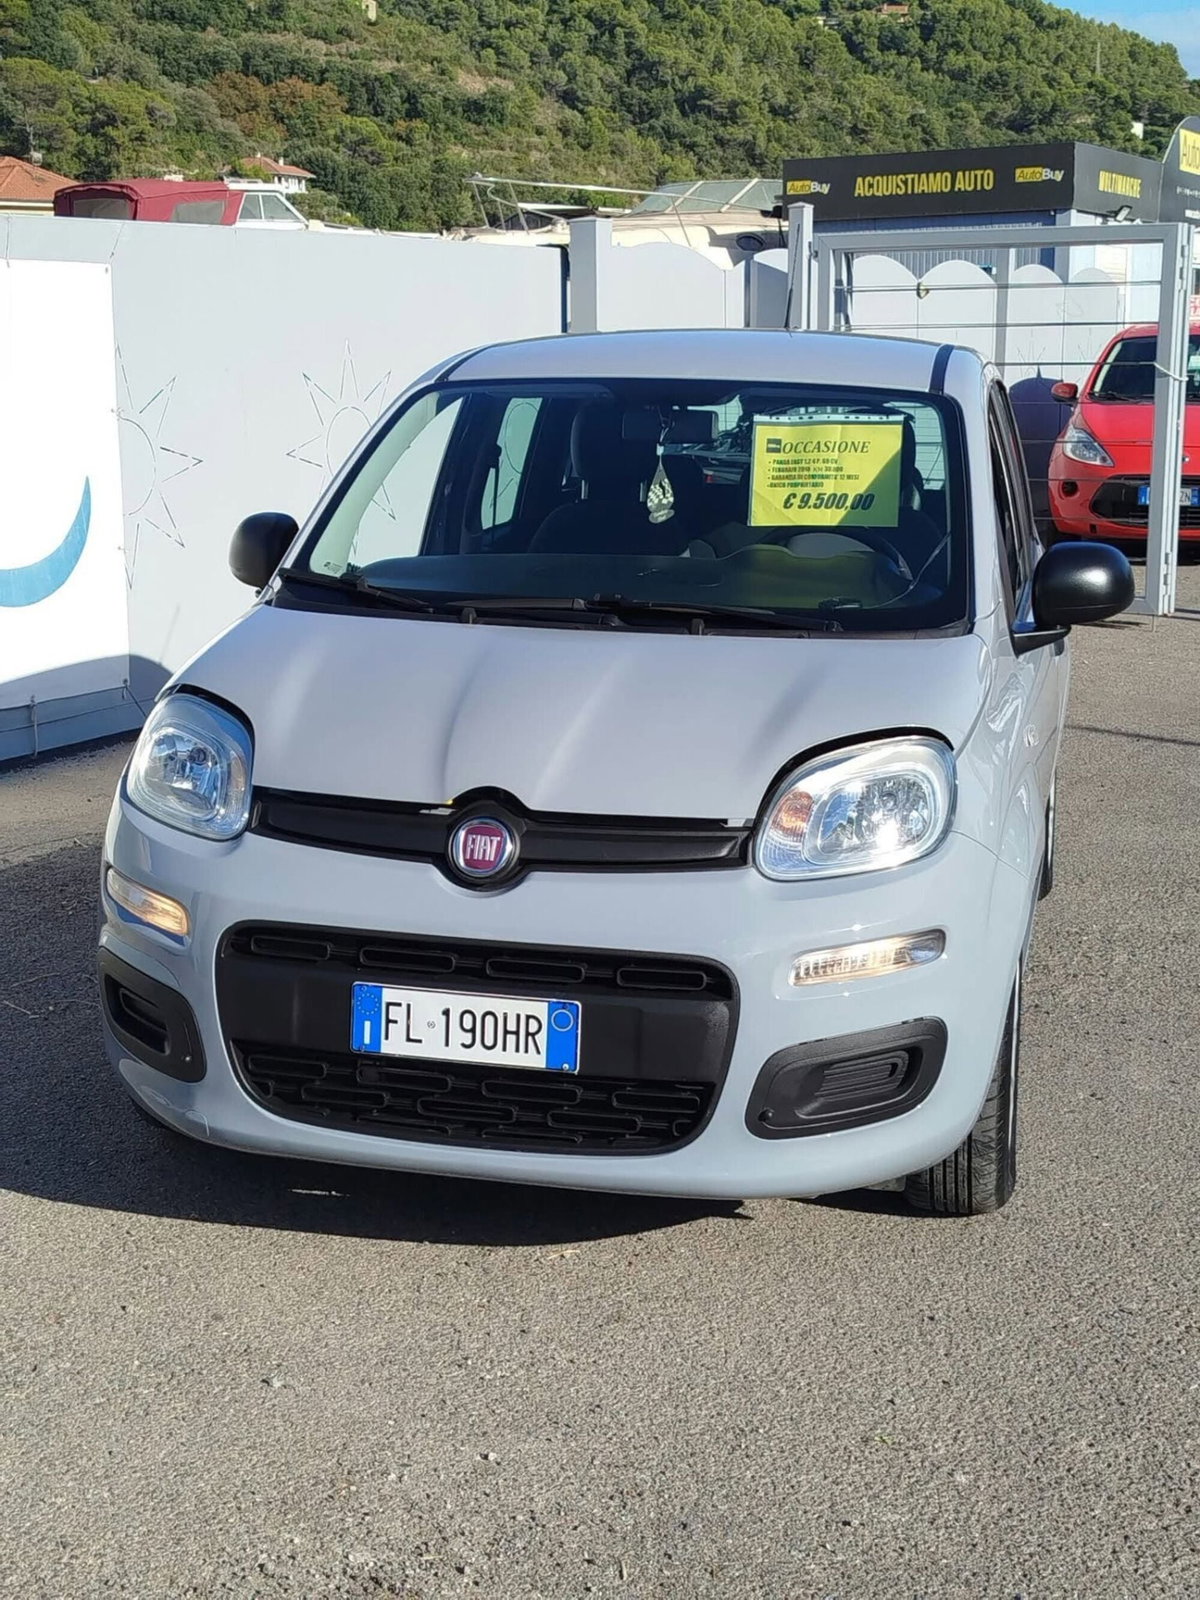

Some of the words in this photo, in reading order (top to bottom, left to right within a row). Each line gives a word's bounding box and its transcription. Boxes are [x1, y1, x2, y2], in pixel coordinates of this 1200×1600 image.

[854, 172, 952, 198] ACQUISTIAMO
[954, 169, 994, 194] AUTO
[1016, 167, 1065, 183] AutoBuy
[787, 180, 831, 196] AutoBuy
[782, 441, 871, 454] OCCASIONE
[783, 492, 797, 509] €
[798, 493, 876, 511] 9.500,00
[465, 834, 501, 861] FIAT
[383, 1001, 423, 1044] FL
[441, 1007, 543, 1055] 190HR
